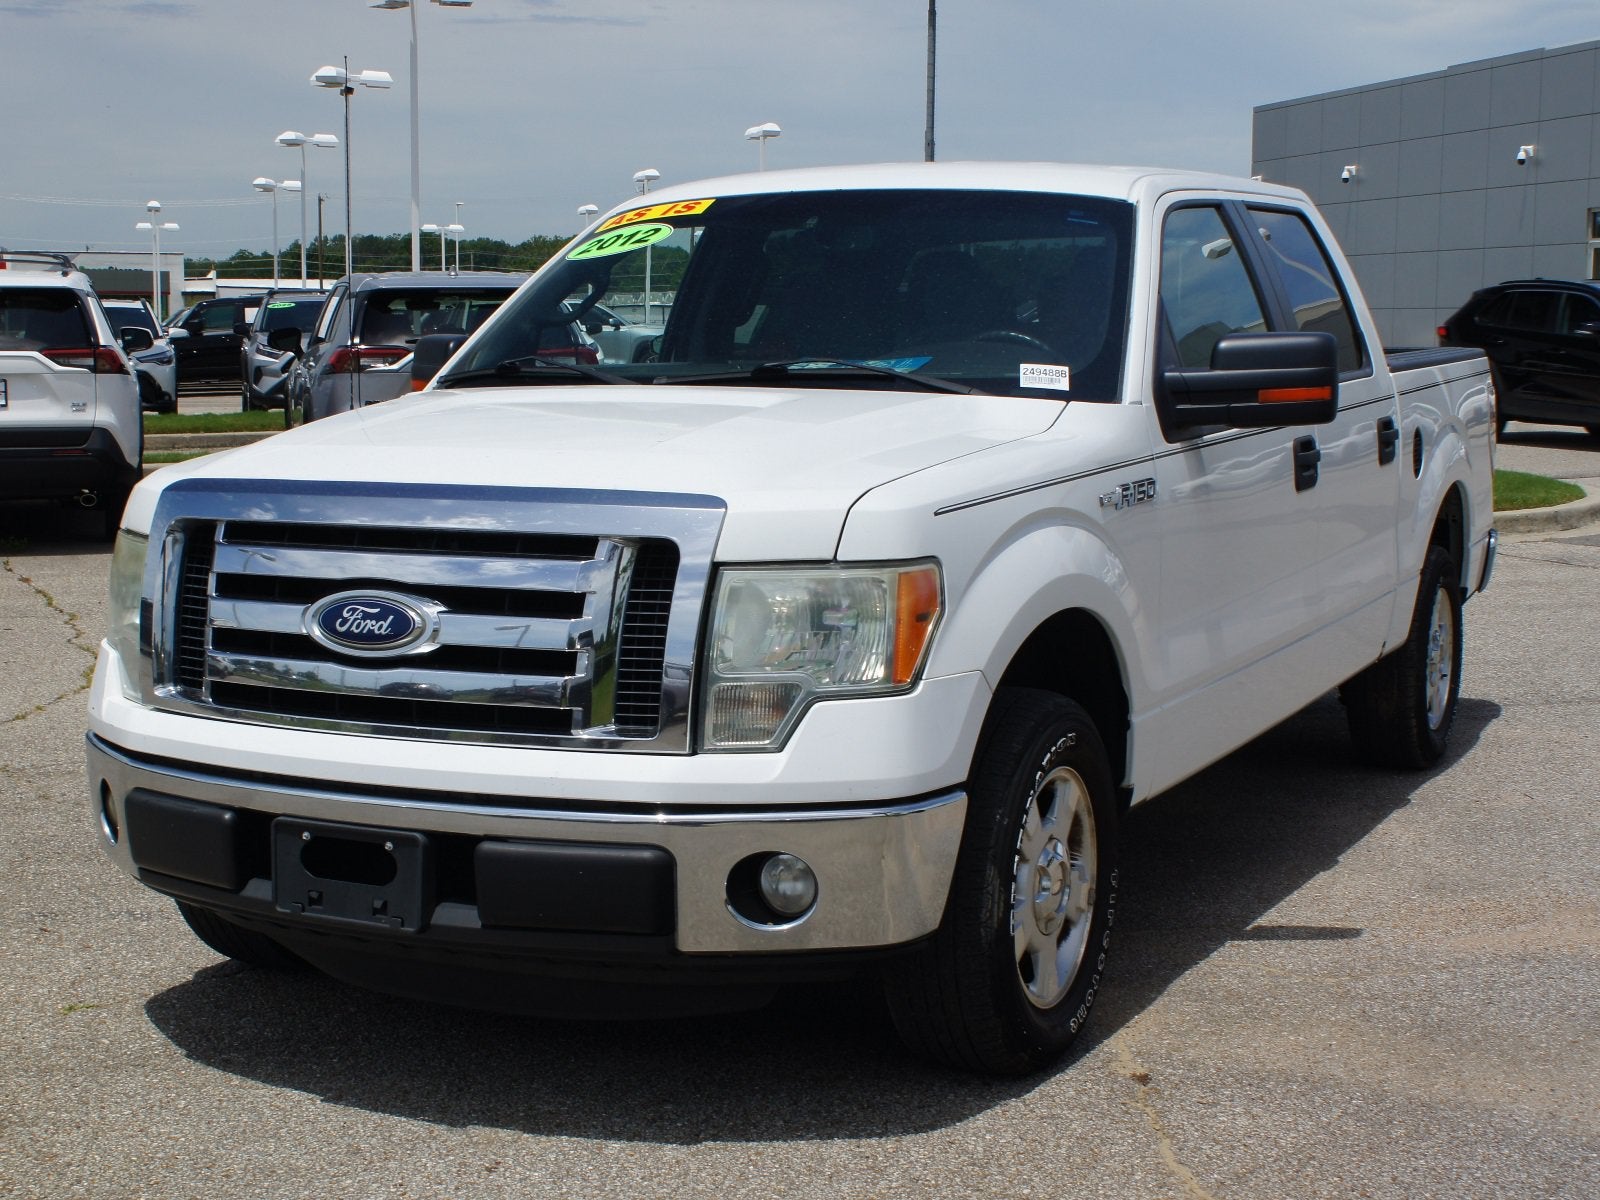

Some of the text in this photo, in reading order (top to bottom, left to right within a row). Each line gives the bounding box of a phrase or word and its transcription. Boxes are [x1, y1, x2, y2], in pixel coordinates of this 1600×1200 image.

[604, 202, 702, 229] AS IS
[574, 227, 662, 257] 2012
[1022, 367, 1067, 378] 249488B
[335, 605, 394, 635] Ford
